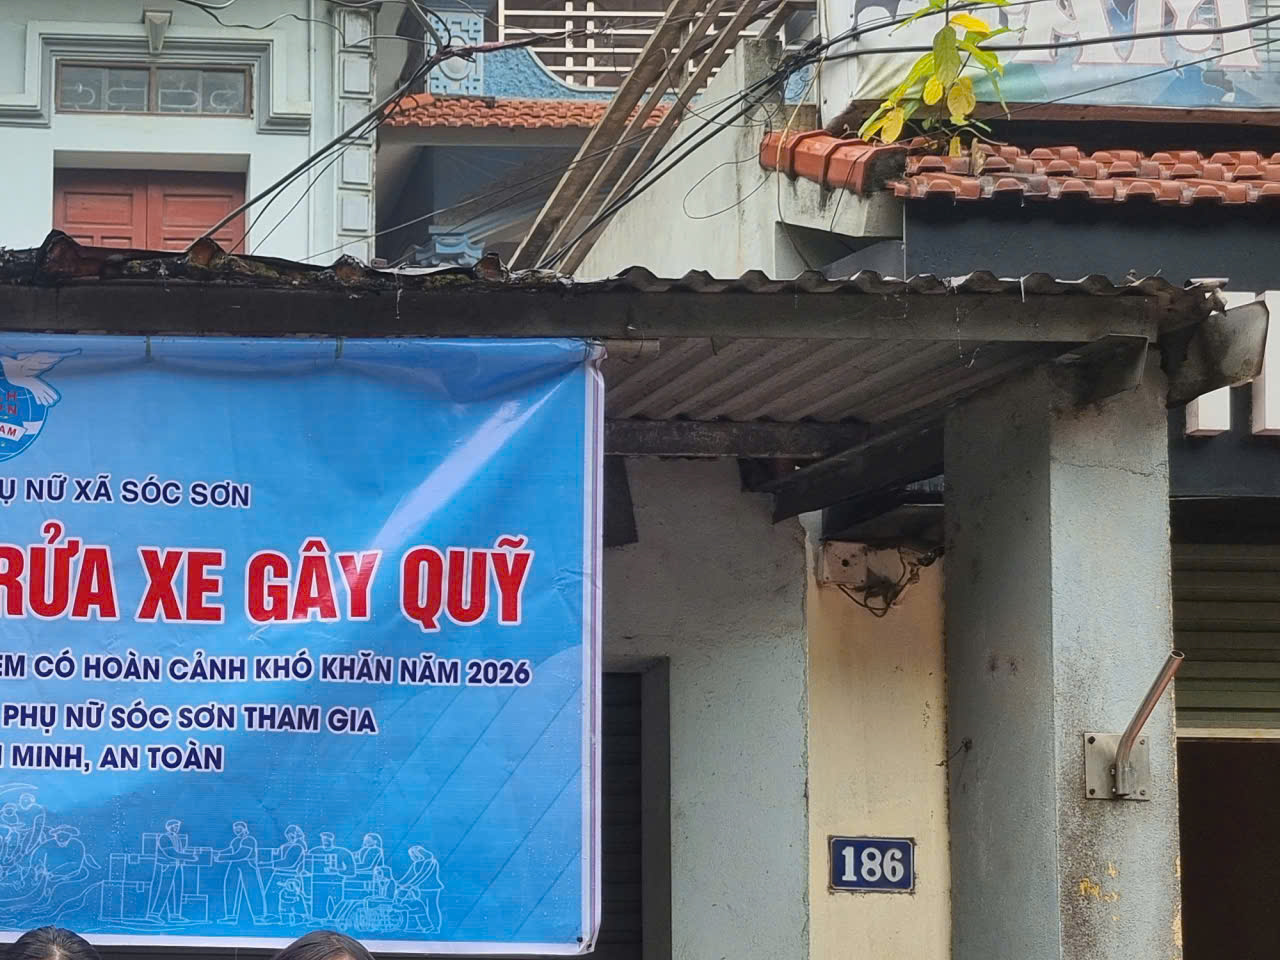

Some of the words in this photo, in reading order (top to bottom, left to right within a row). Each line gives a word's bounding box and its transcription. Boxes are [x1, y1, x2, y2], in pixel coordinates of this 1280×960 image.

[27, 475, 66, 500] NỮ
[75, 476, 111, 501] XÃ
[122, 477, 180, 503] SÓC
[191, 482, 248, 506] SƠN
[140, 549, 222, 621] XE
[248, 540, 377, 621] GÂY
[404, 538, 530, 628] QUỸ
[35, 651, 74, 677] CÓ
[85, 652, 159, 679] HOÀN
[170, 652, 244, 680] CẢNH
[256, 651, 311, 678] KHÓ
[322, 653, 391, 681] KHĂN
[401, 655, 458, 683] NĂM
[469, 662, 529, 683] 2026
[4, 705, 55, 733] PHỤ
[67, 702, 104, 728] NỮ
[112, 702, 168, 728] SÓC
[179, 704, 234, 728] SƠN
[244, 707, 318, 730] THAM
[329, 709, 375, 732] GIA
[13, 746, 89, 771] MINH,
[100, 748, 137, 768] AN
[148, 741, 221, 769] TOÀN
[842, 846, 904, 882] 186
